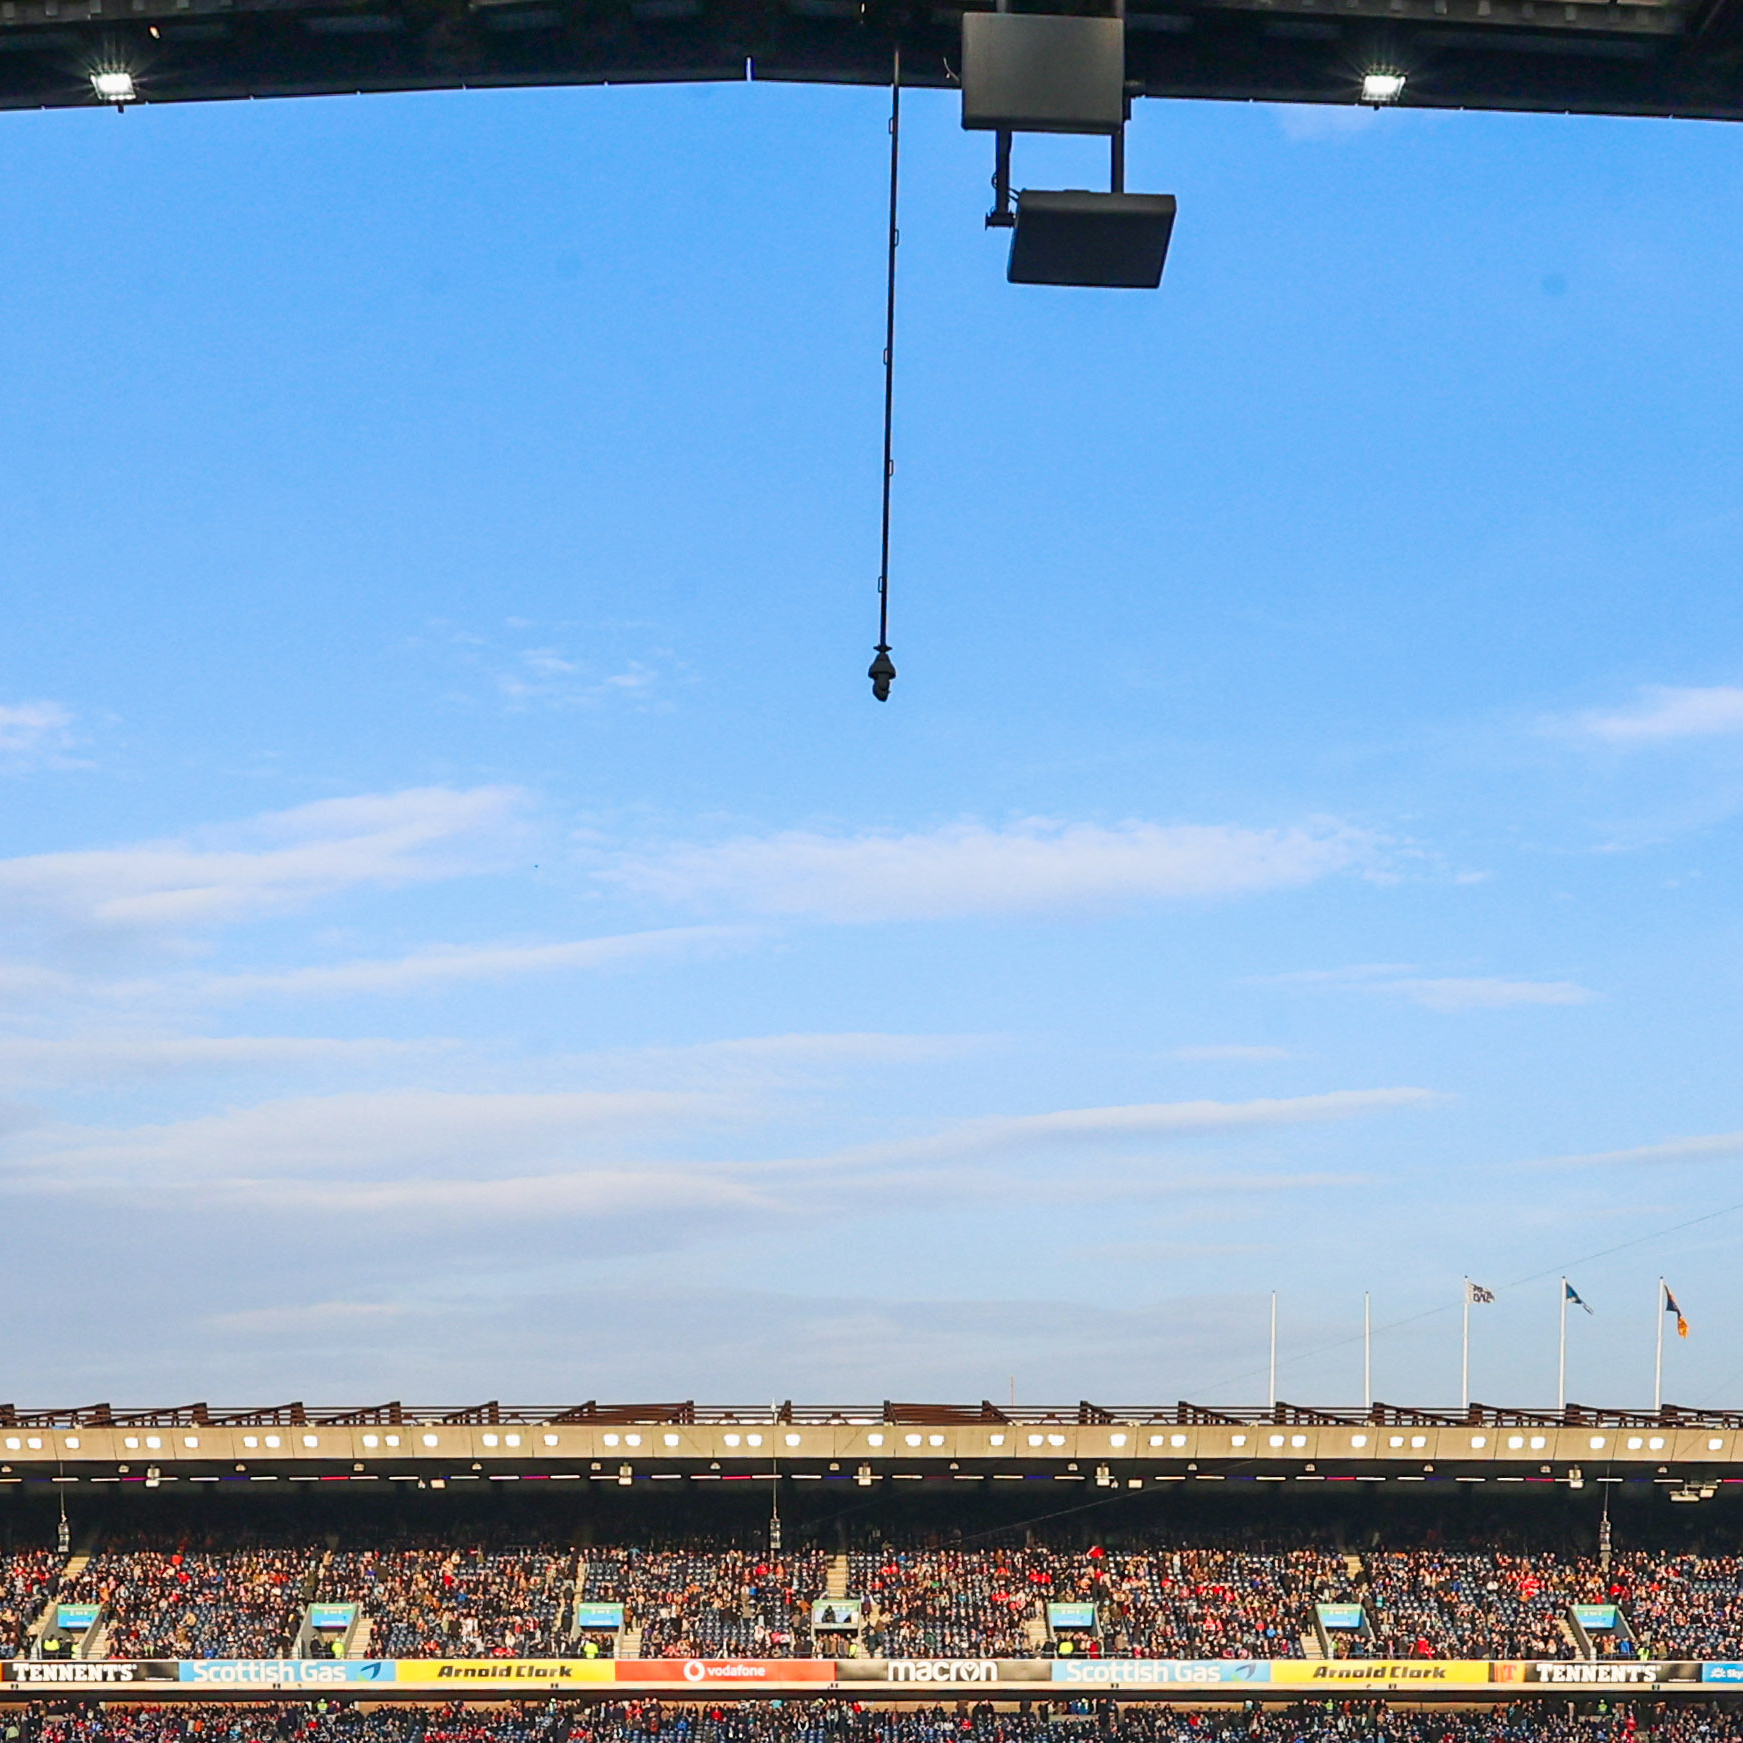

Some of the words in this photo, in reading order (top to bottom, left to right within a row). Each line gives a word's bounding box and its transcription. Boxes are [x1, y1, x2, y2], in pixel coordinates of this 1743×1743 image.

[13, 1663, 137, 1682] TENNENT'S
[193, 1661, 296, 1682] Scottish
[300, 1663, 347, 1682] Gas
[438, 1665, 512, 1678] Arnold
[516, 1665, 573, 1678] Clark
[707, 1664, 765, 1678] vodafone
[887, 1661, 998, 1682] macron
[1065, 1661, 1167, 1682] Scottish
[1173, 1663, 1221, 1682] Gas
[1313, 1665, 1386, 1679] Arnold
[1389, 1665, 1446, 1679] Clark
[1536, 1663, 1661, 1682] TENNENT'S
